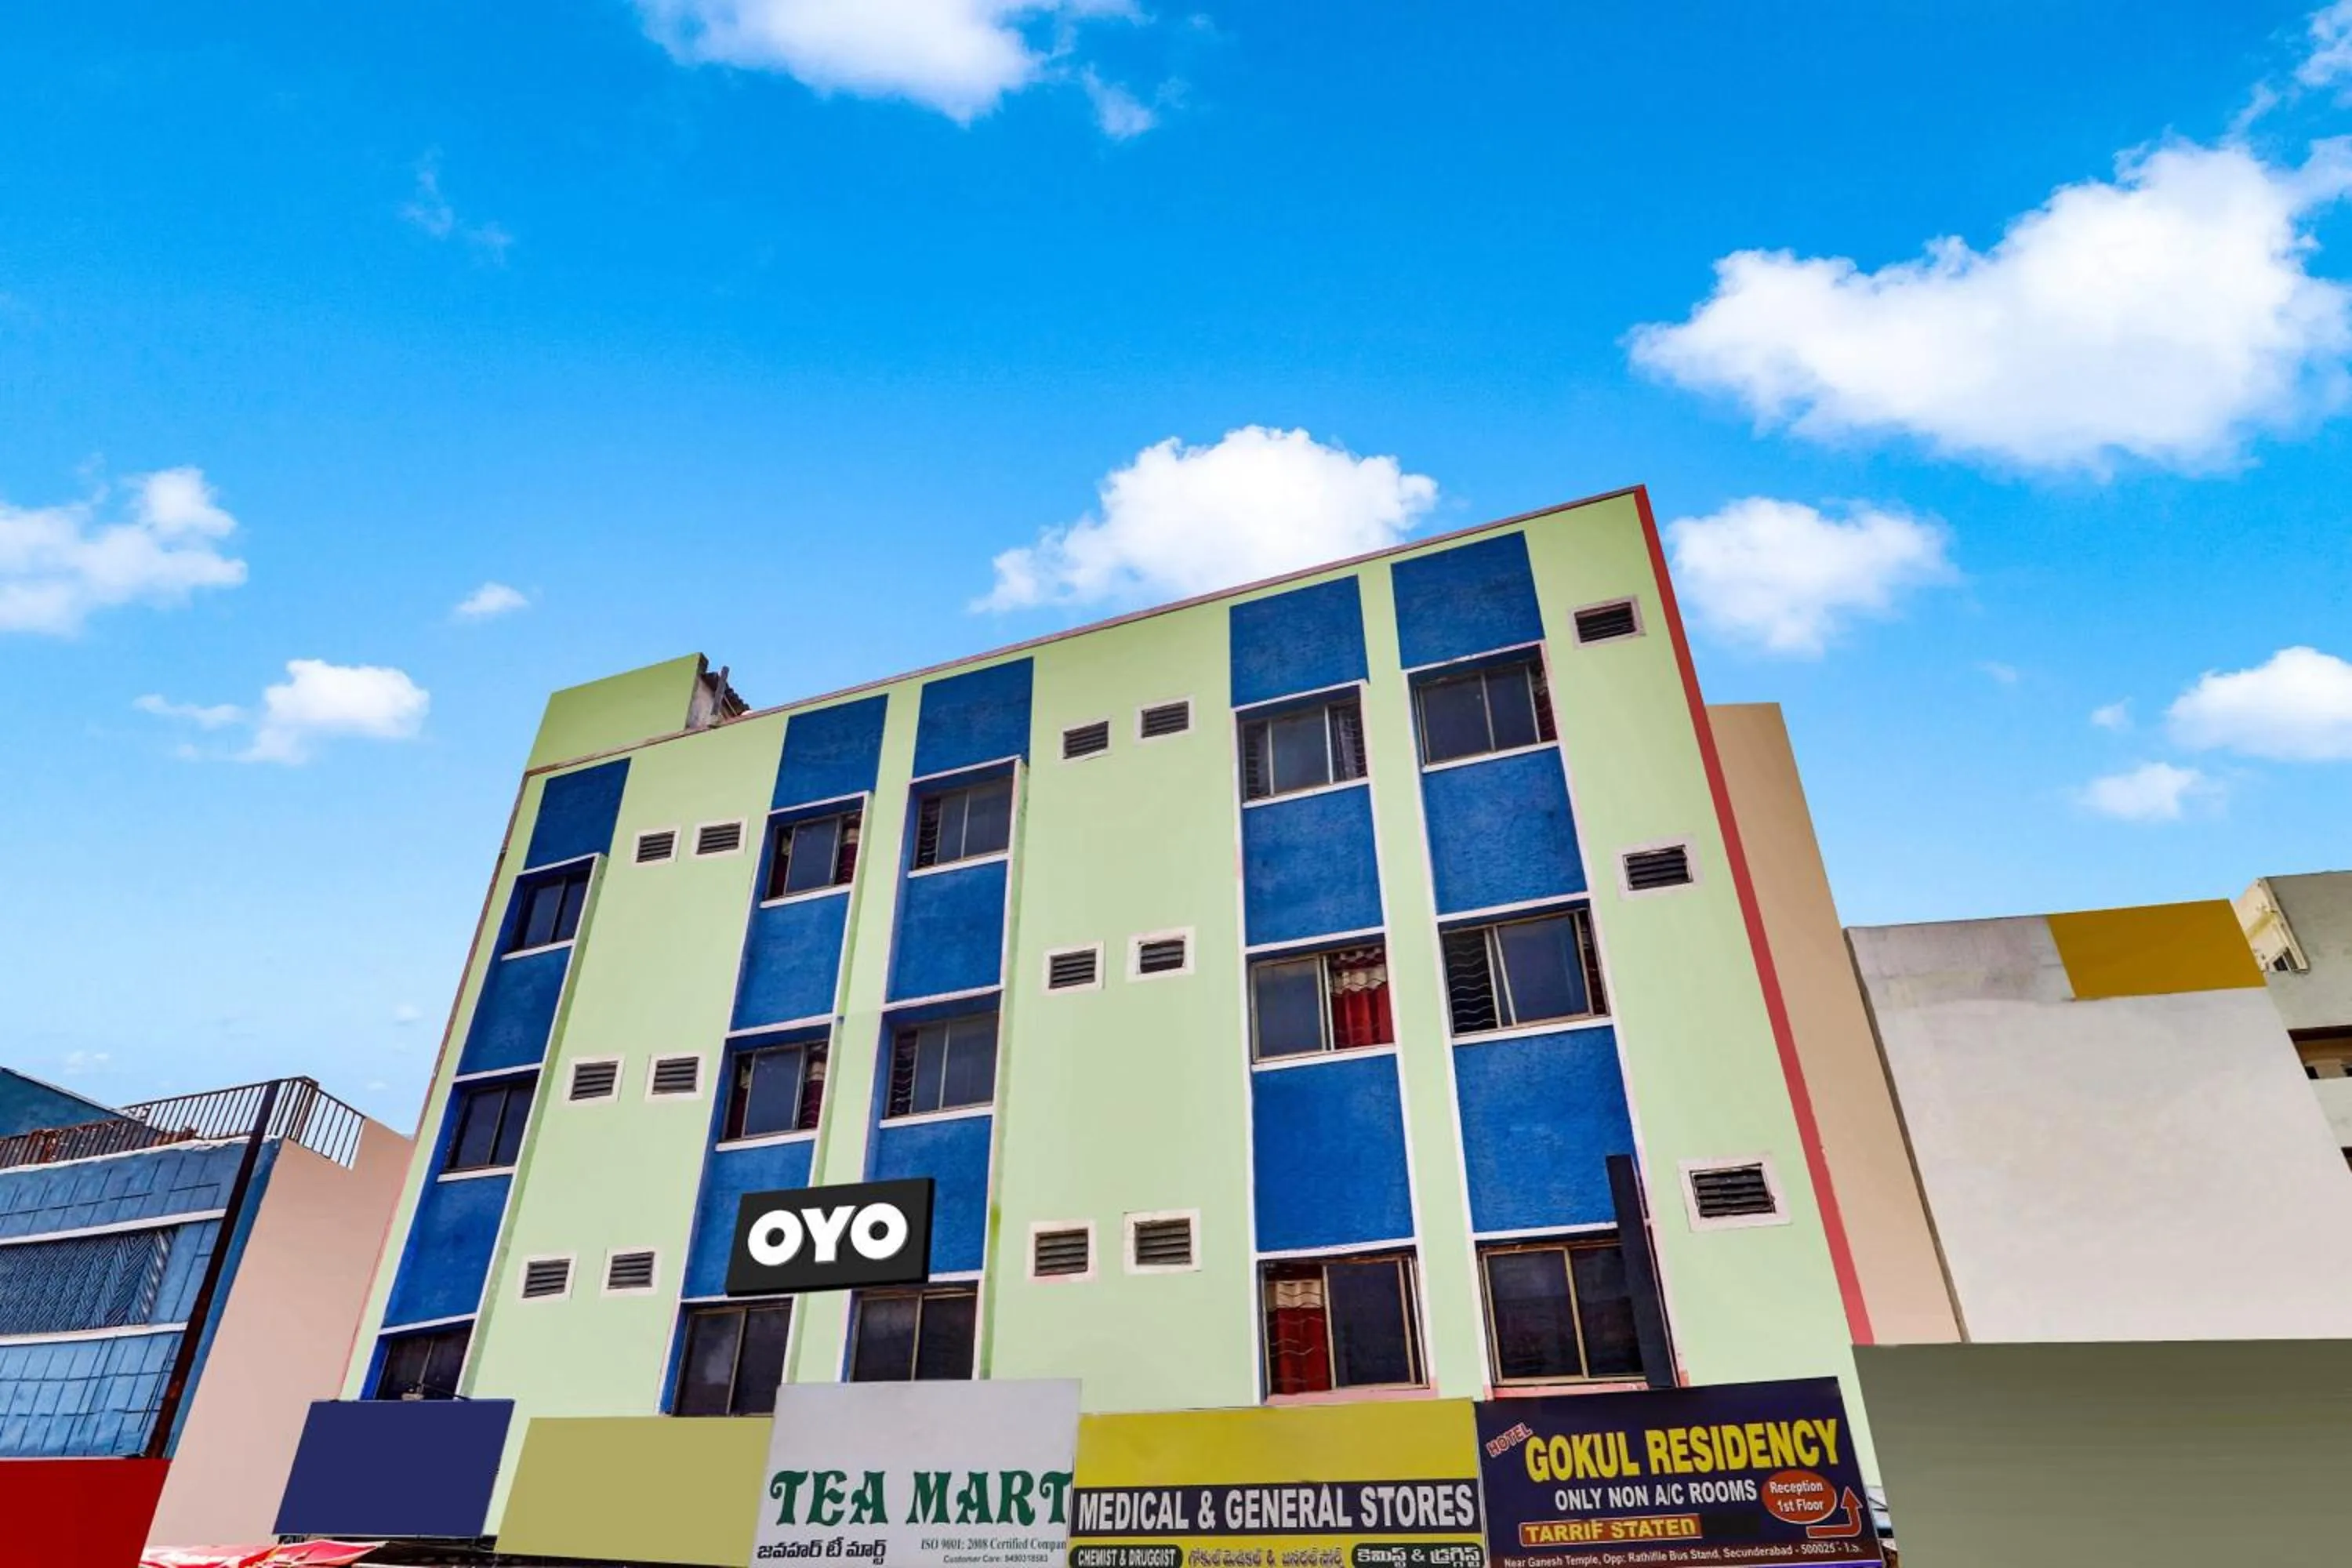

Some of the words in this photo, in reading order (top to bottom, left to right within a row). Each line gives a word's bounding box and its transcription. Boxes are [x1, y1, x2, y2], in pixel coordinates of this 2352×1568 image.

[747, 1202, 909, 1266] OYO
[1486, 1421, 1534, 1457] HOTEL
[1525, 1432, 1641, 1483] GOKUL
[1644, 1418, 1838, 1475] RESIDENCY
[769, 1470, 889, 1526] TEA
[906, 1470, 1073, 1526] MART
[1555, 1487, 1602, 1512] ONLY
[1608, 1485, 1650, 1508] NON
[1655, 1483, 1685, 1506] A/C
[1688, 1479, 1758, 1504] ROOMS
[1769, 1480, 1824, 1496] Reception
[1077, 1491, 1189, 1530] MEDICAL
[1197, 1490, 1215, 1529] &
[1225, 1484, 1352, 1529] GENERAL
[1359, 1484, 1475, 1527] STORES
[1777, 1499, 1795, 1512] 1st
[1796, 1498, 1824, 1512] Floor
[1525, 1519, 1604, 1543] TARRIF
[921, 1538, 938, 1550] ISO
[990, 1537, 1029, 1550] Certified
[1030, 1538, 1067, 1552] Compan
[1411, 1548, 1425, 1562] &
[1504, 1557, 1526, 1568] Near
[1528, 1555, 1563, 1568] Ganesh
[1565, 1555, 1602, 1567] Temple,
[1669, 1549, 1688, 1562] Bus
[1690, 1548, 1722, 1561] Stand,
[1722, 1544, 1794, 1559] Secunderabad
[1801, 1543, 1835, 1555] 500025
[943, 1555, 980, 1563] Customer
[1078, 1548, 1118, 1566] CHEMIST
[1119, 1548, 1127, 1566] &
[1129, 1548, 1176, 1566] DRUGGIST
